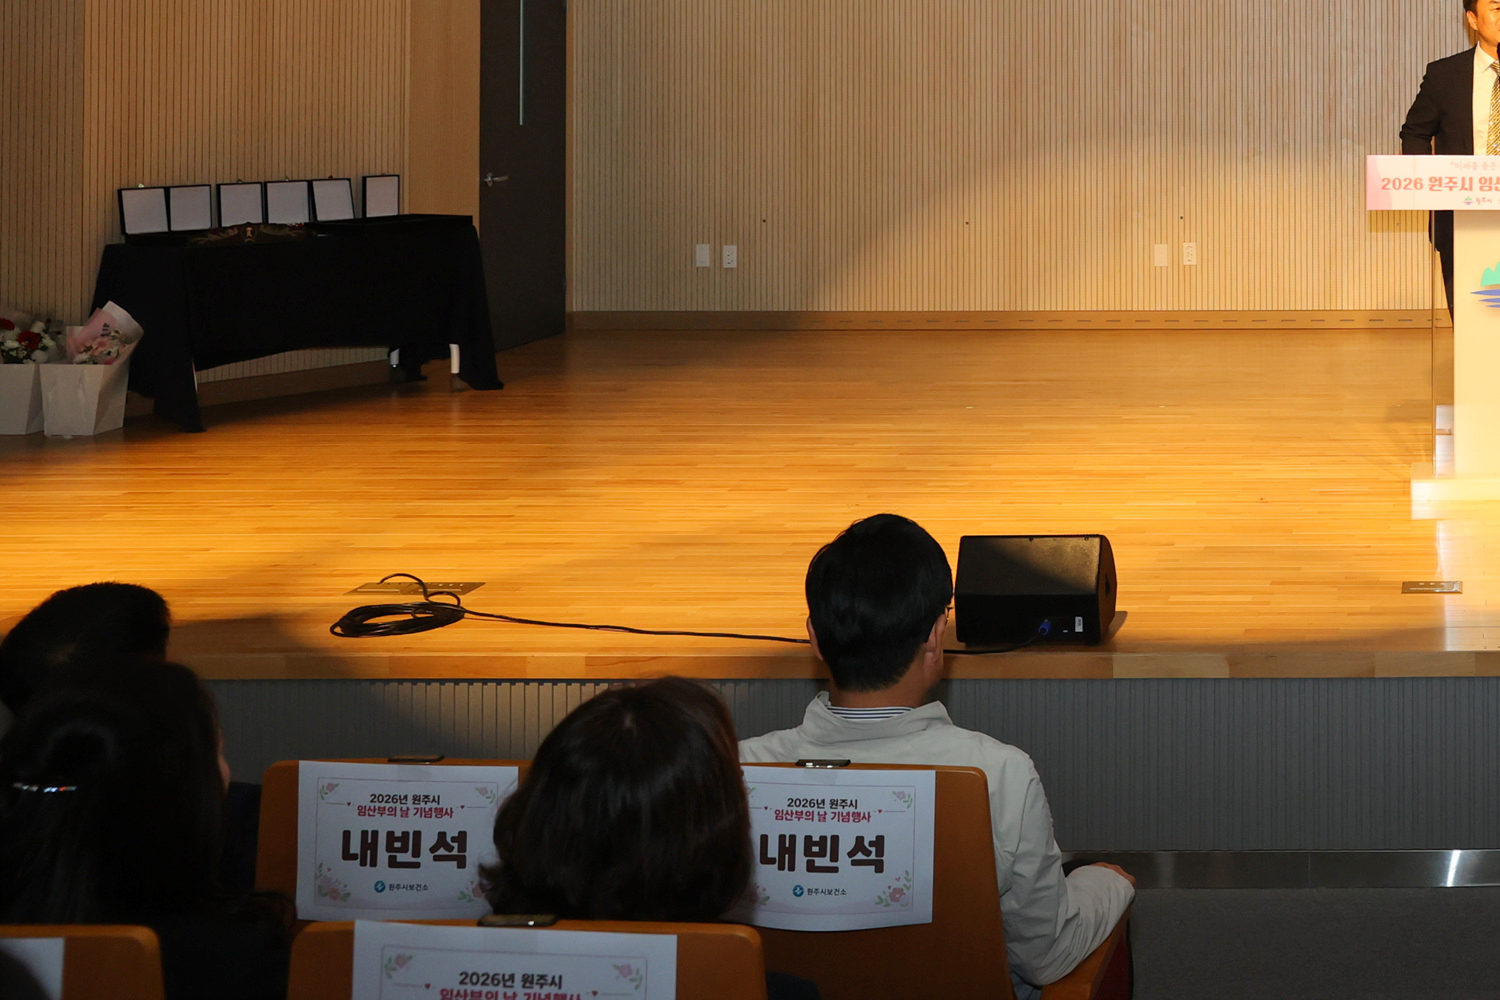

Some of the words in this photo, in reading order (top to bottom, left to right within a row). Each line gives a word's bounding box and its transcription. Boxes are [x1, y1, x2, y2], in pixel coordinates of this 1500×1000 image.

[1381, 177, 1423, 191] 2026
[1428, 176, 1473, 192] 원주시
[370, 794, 408, 805] 2026년
[412, 794, 440, 806] 원주시
[787, 798, 826, 809] 2026년
[829, 798, 858, 810] 원주시
[357, 805, 397, 817] 임산부의
[400, 806, 410, 818] 날
[413, 806, 454, 819] 기념행사
[774, 810, 814, 822] 임산부의
[817, 810, 828, 823] 날
[831, 810, 871, 823] 기념행사
[341, 829, 467, 869] 내빈석
[760, 834, 885, 874] 내빈석
[388, 882, 428, 892] 원주시보건소
[806, 887, 847, 896] 원주시보건소
[459, 972, 515, 988] 2026년
[521, 973, 563, 990] 원주시
